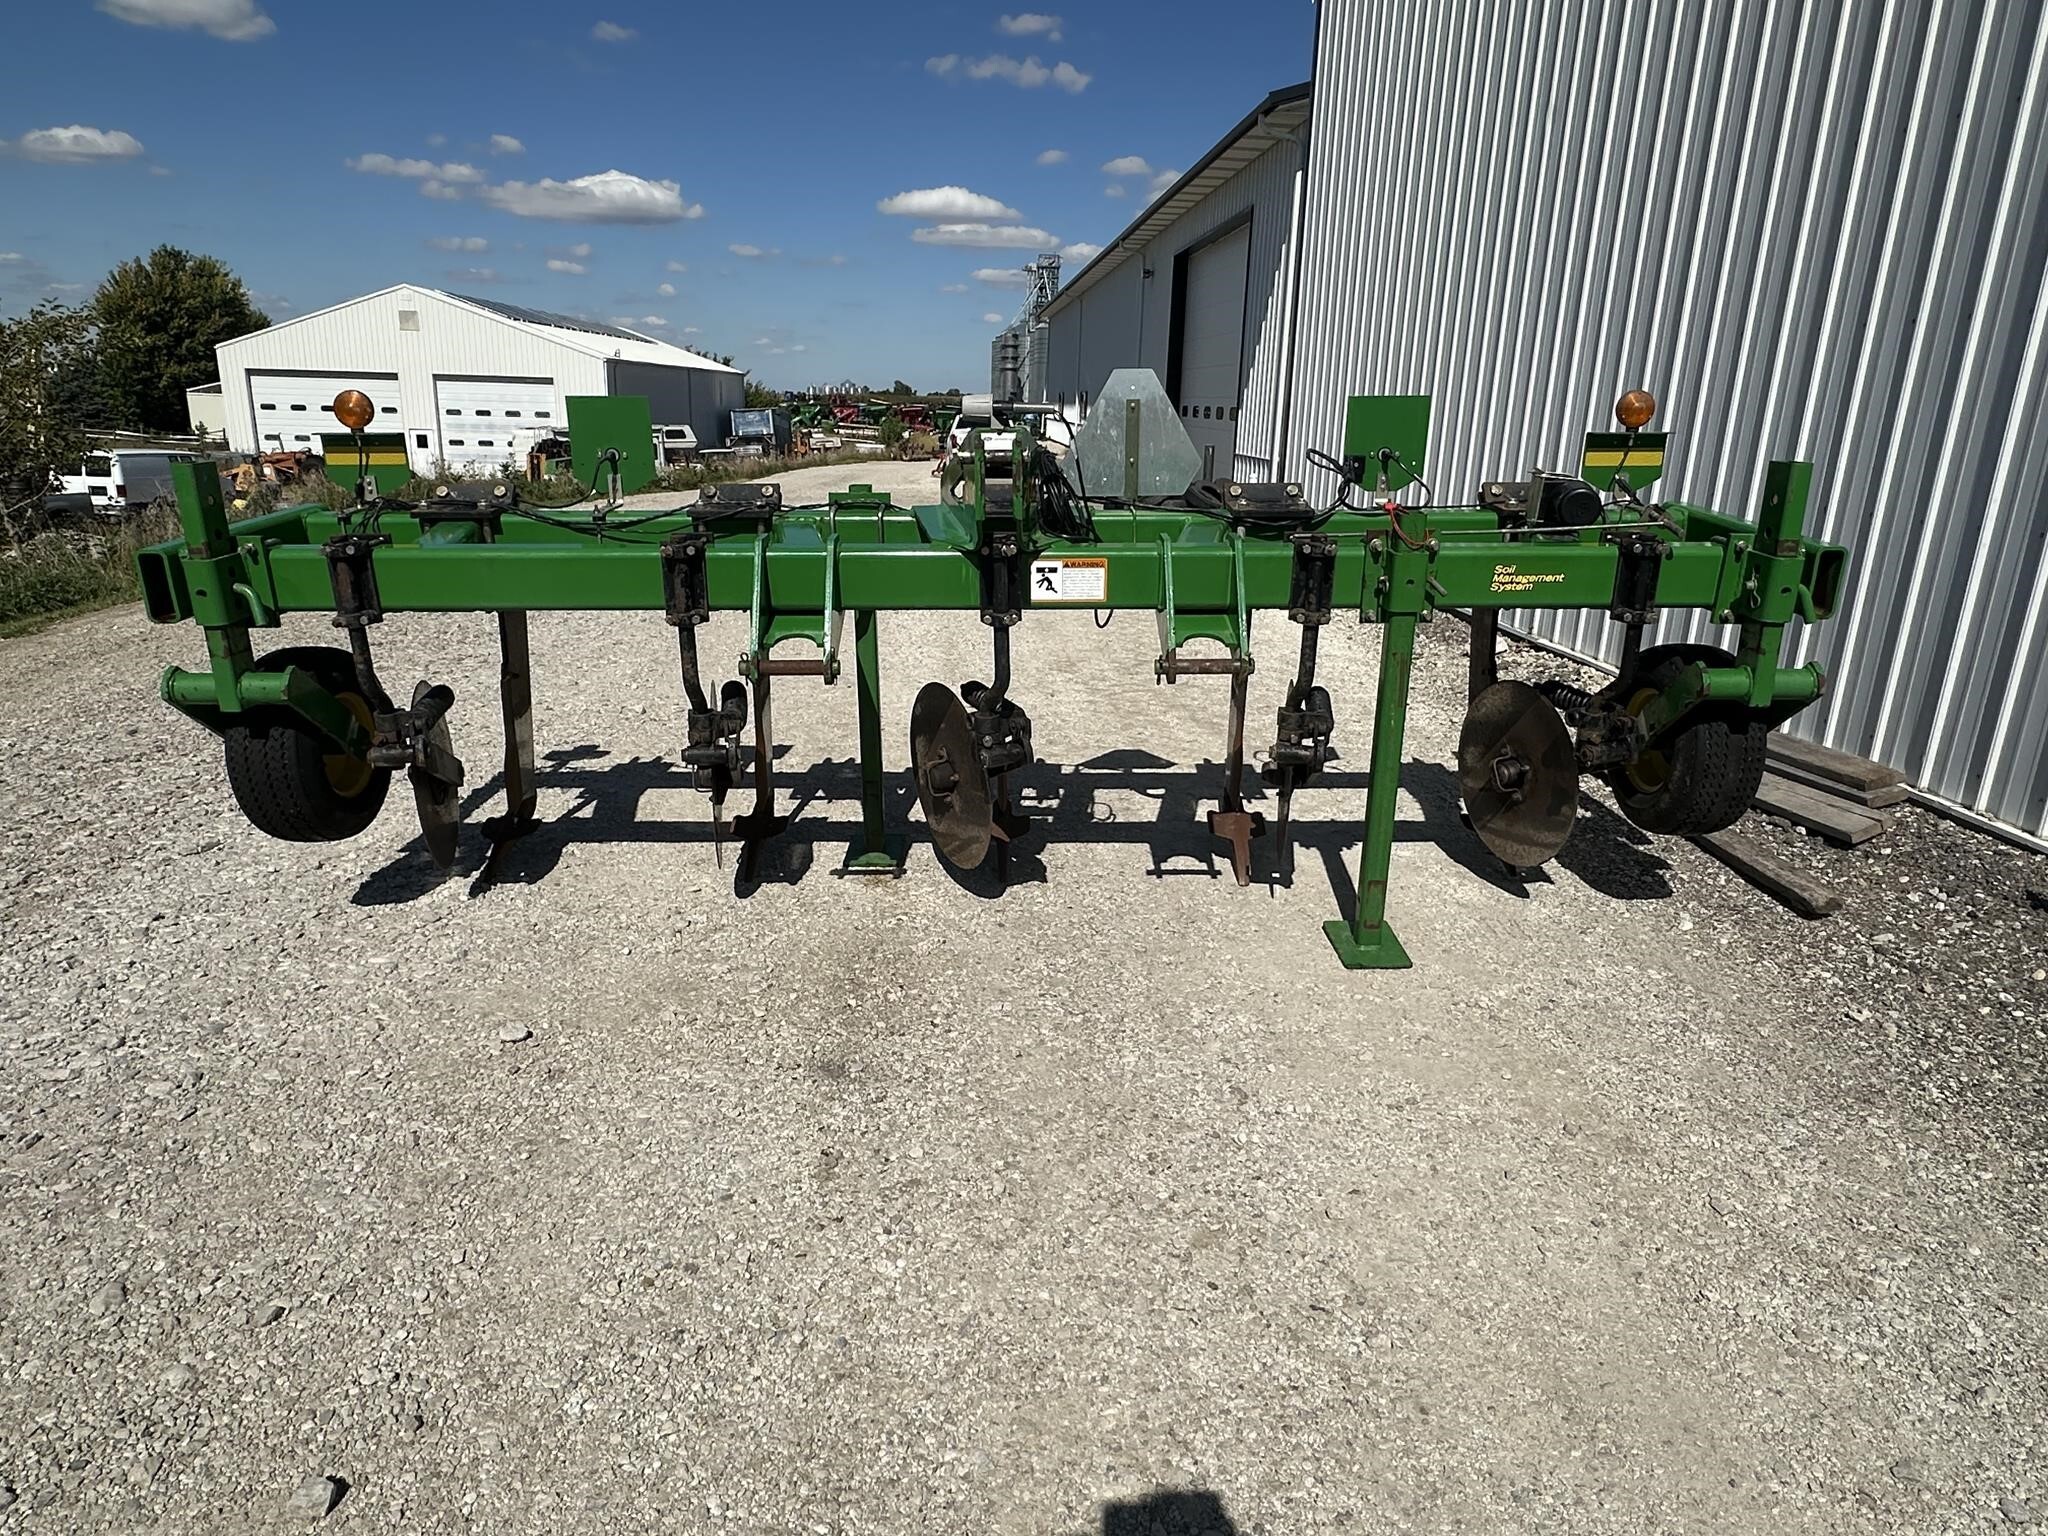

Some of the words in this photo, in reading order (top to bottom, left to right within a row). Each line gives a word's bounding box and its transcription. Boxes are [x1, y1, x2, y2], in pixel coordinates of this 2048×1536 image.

[1494, 565, 1516, 574] Soil
[1492, 573, 1565, 583] Management
[1490, 582, 1533, 592] System
